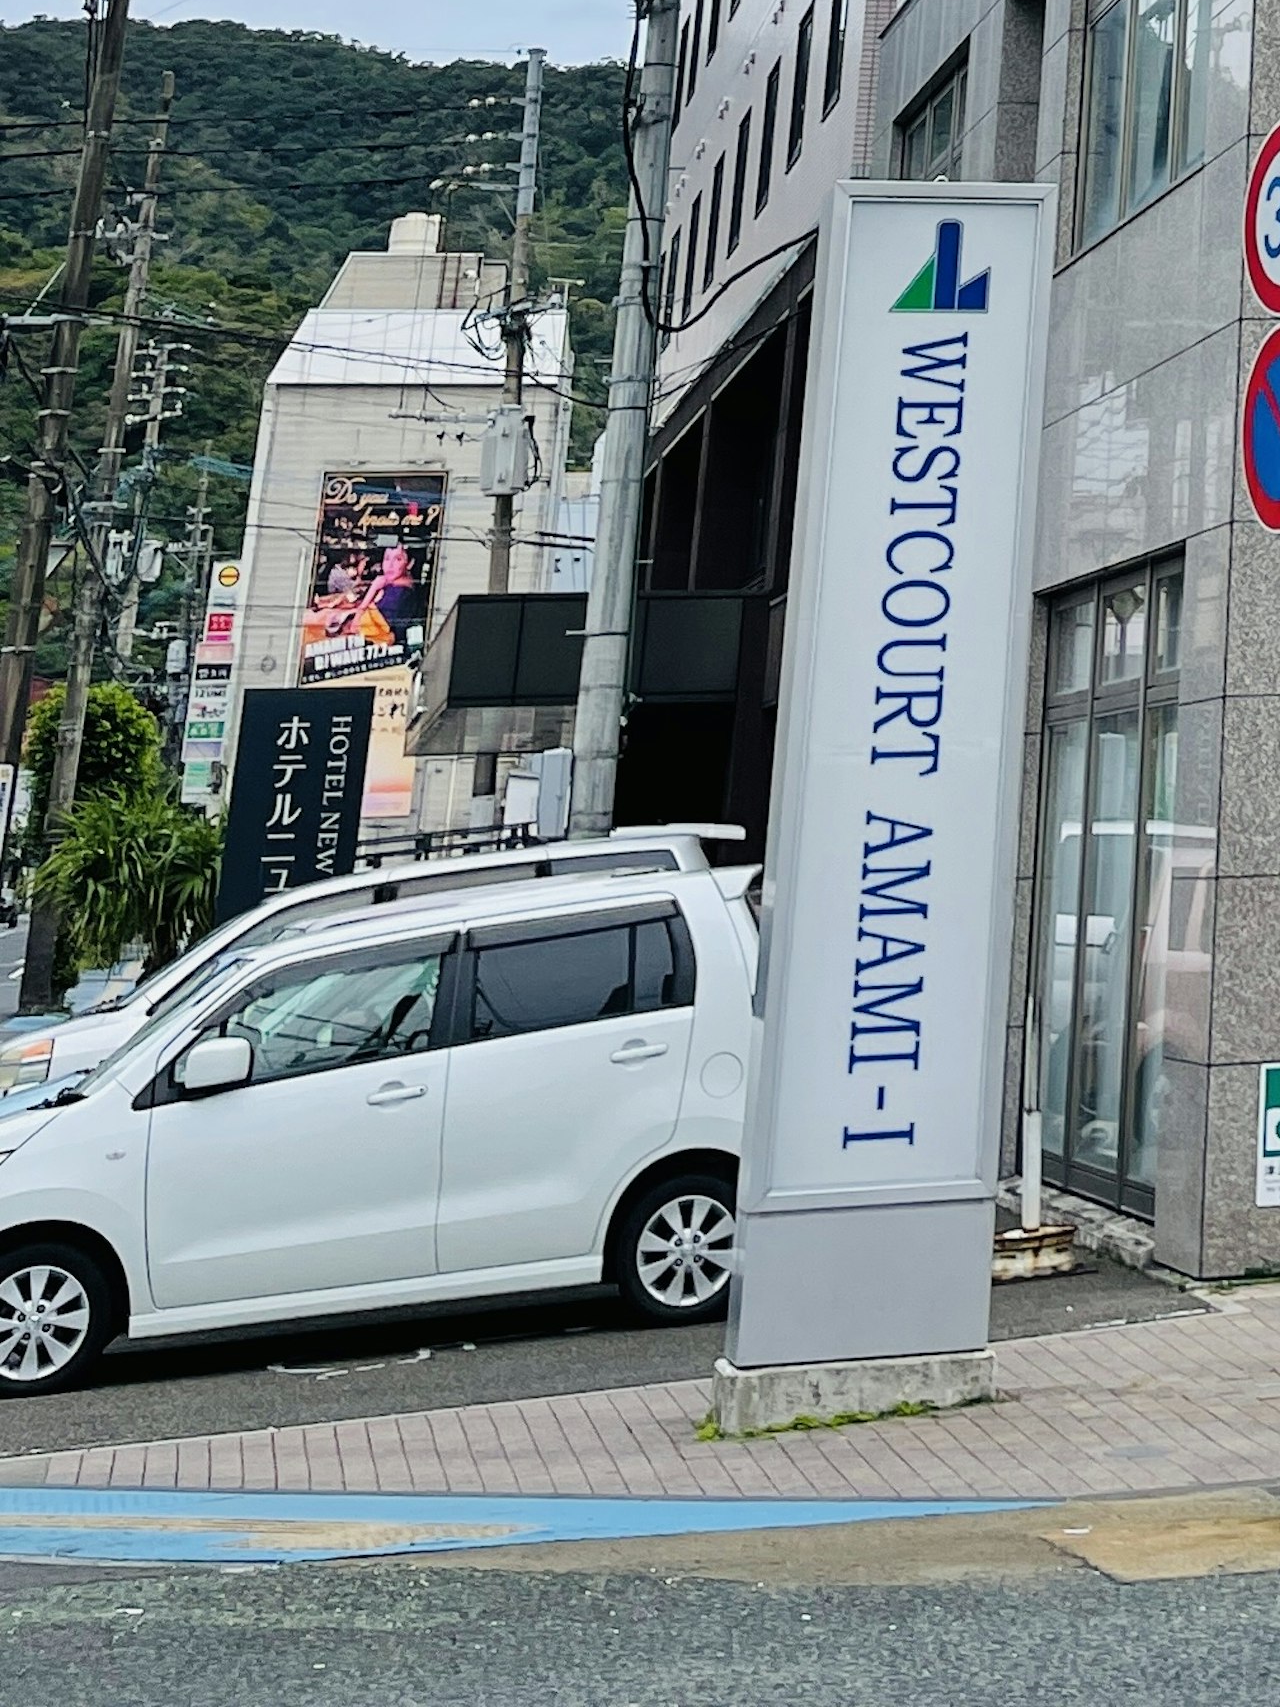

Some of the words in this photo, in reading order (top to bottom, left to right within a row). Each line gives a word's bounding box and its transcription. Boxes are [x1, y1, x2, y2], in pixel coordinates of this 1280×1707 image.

[324, 476, 357, 505] Do
[353, 493, 390, 511] you
[357, 505, 400, 537] know
[868, 330, 968, 777] WESTCOURT
[322, 716, 352, 806] HOTEL
[315, 812, 341, 875] NEW
[842, 809, 934, 1151] AMAMI-I
